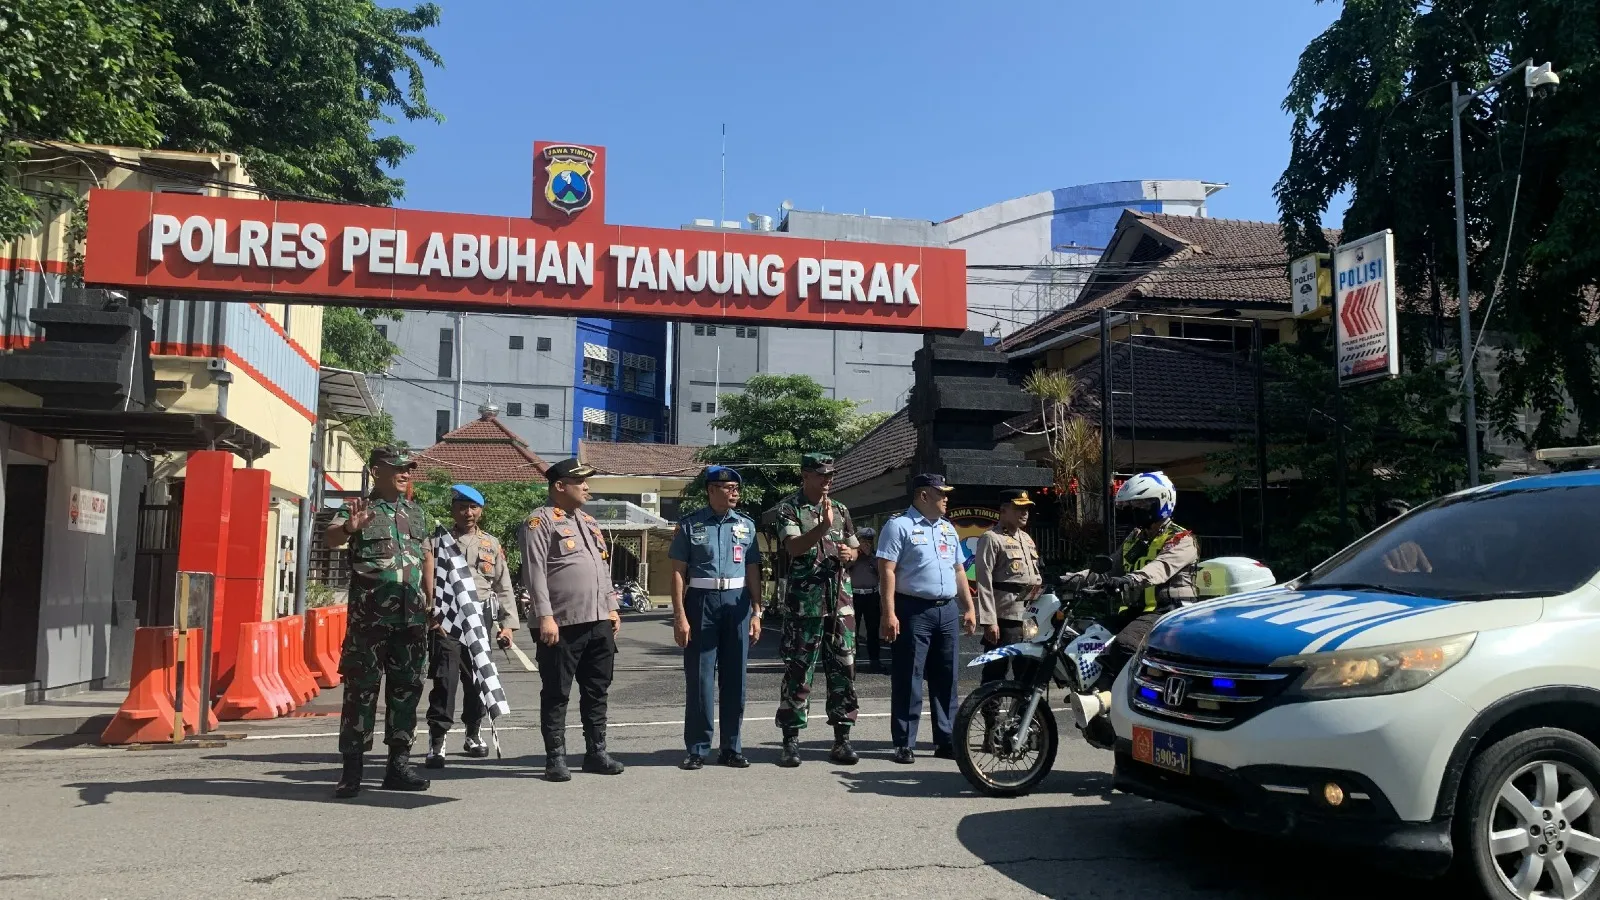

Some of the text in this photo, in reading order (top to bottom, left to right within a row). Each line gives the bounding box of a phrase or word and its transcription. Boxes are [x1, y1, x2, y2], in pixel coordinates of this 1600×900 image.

[548, 148, 593, 159] JAWA TIMUR
[150, 215, 921, 306] POLRES PELABUHAN TANJUNG PERAK
[1294, 272, 1316, 286] POLISI
[1340, 258, 1382, 290] POLISI
[1367, 339, 1382, 347] PERAK
[949, 508, 1000, 520] JAWA TIMUR
[1155, 747, 1186, 769] 5905-V
